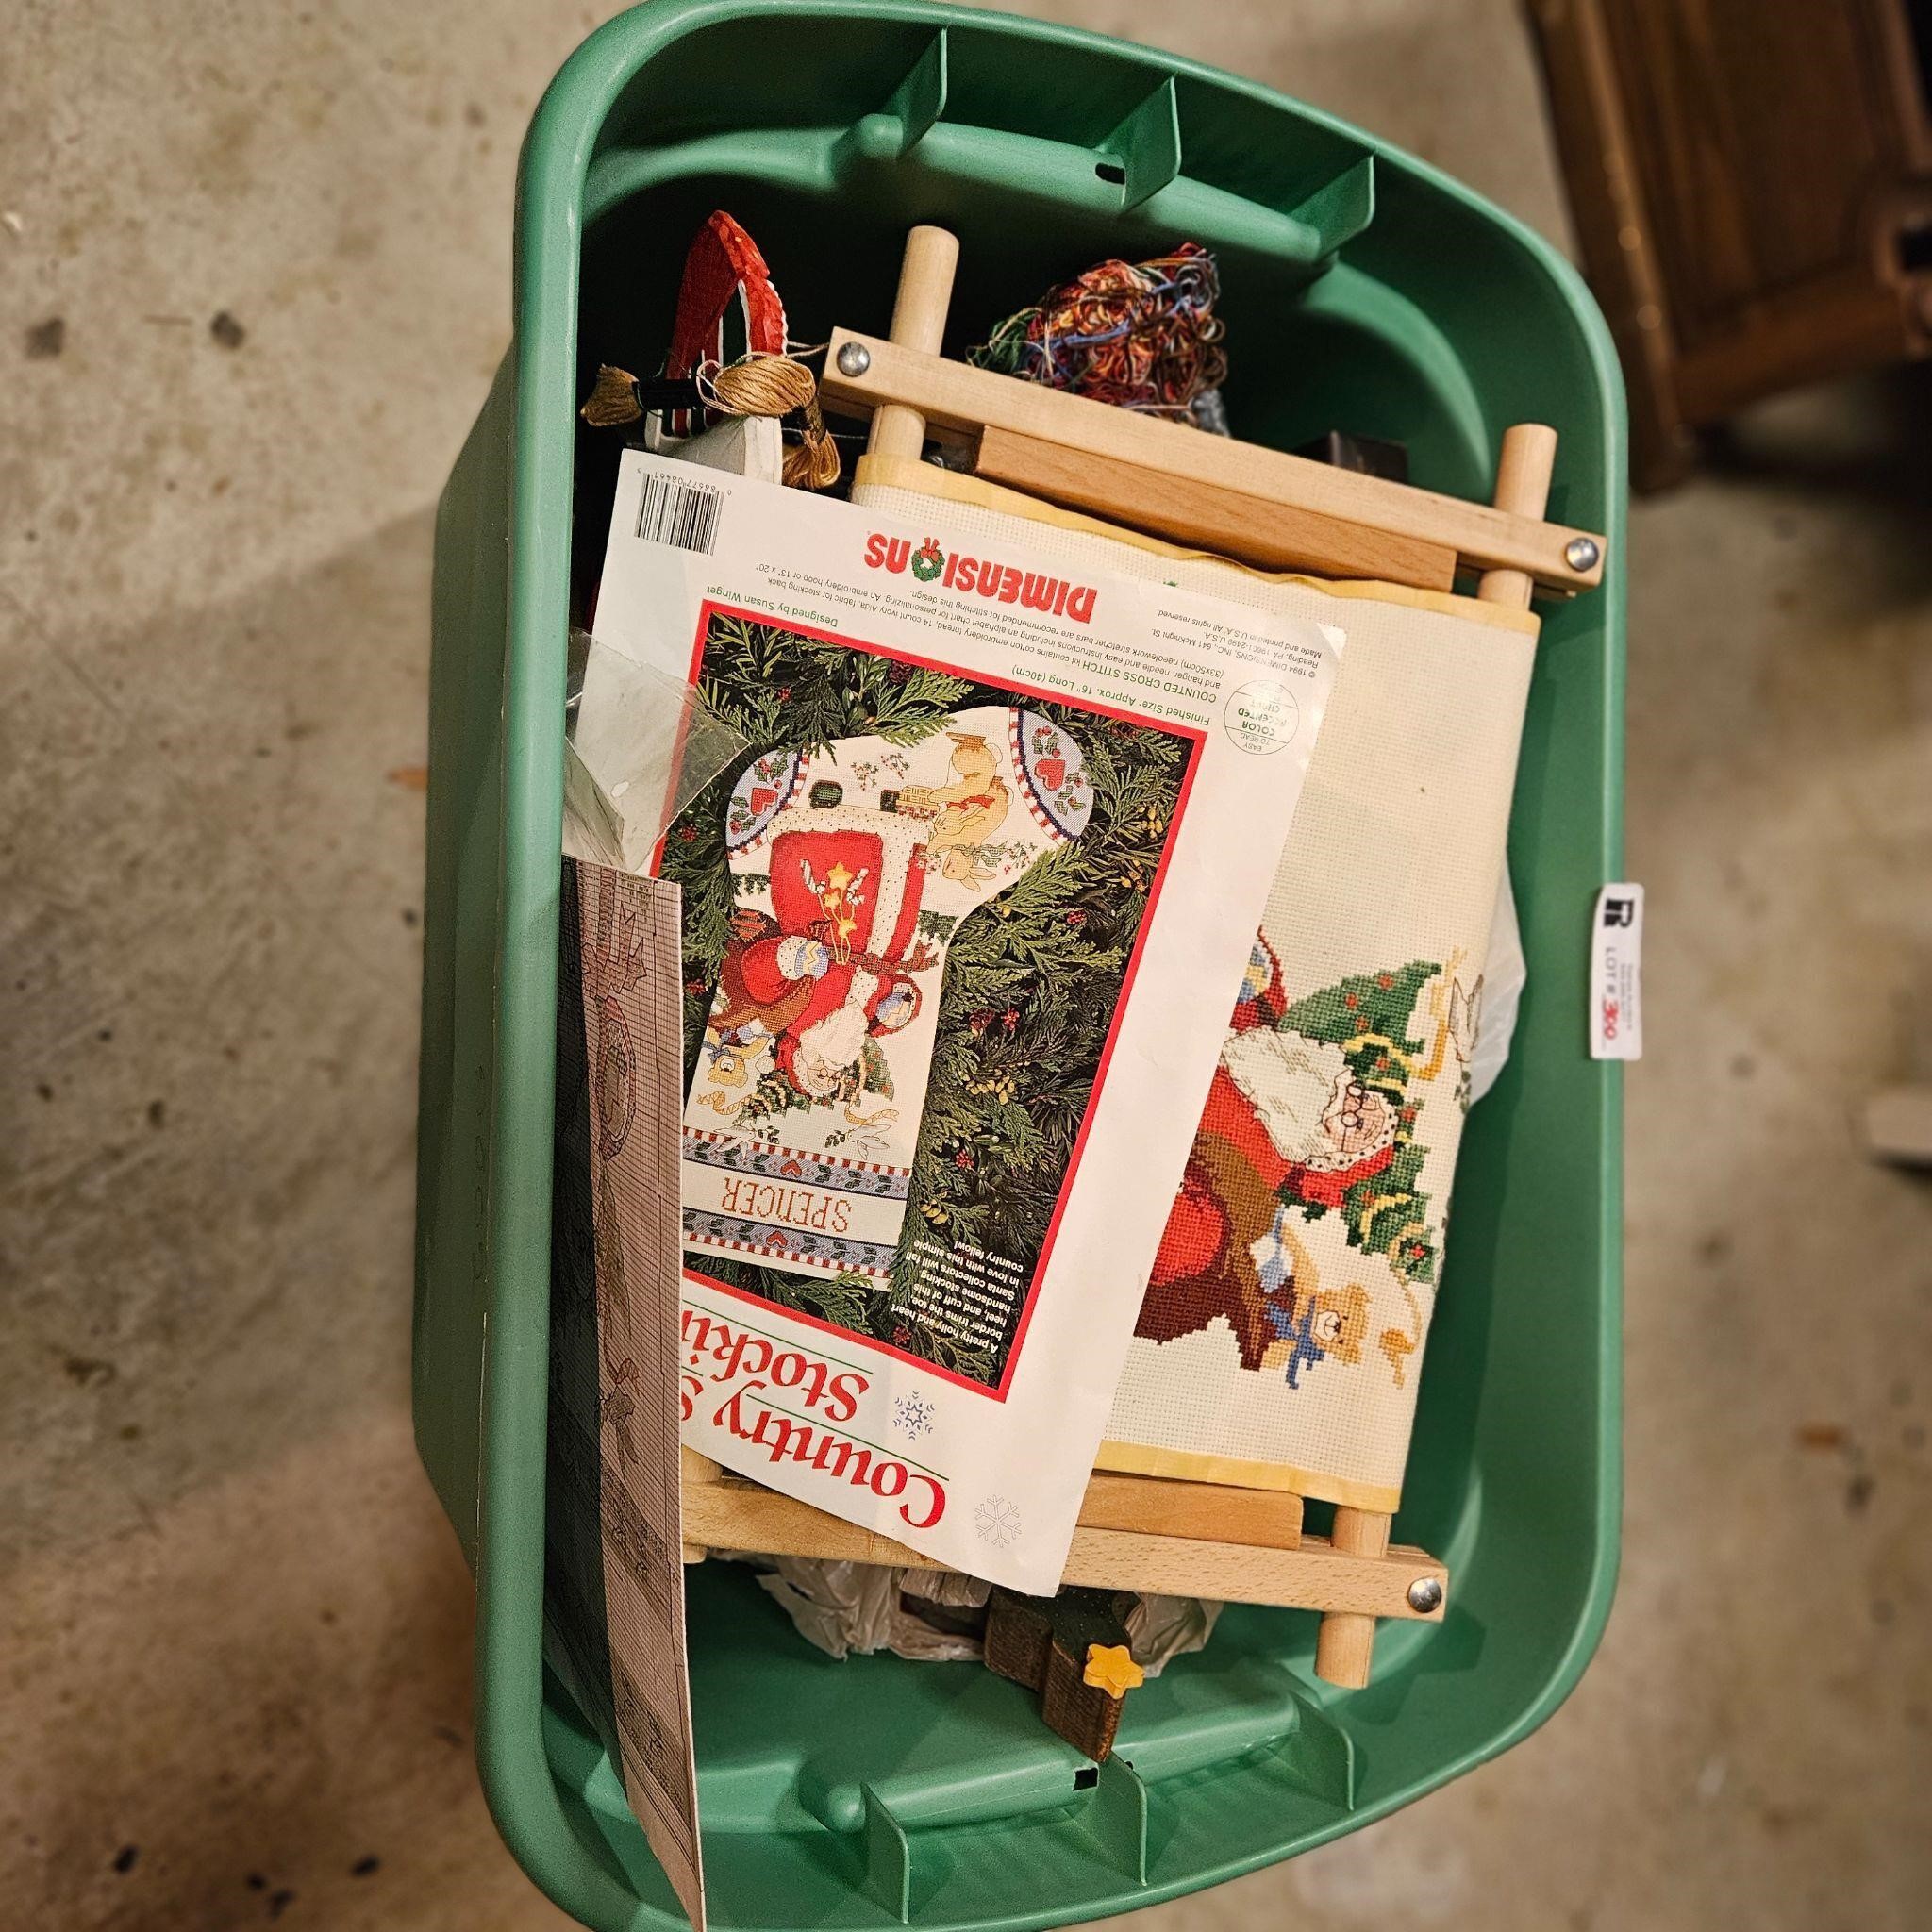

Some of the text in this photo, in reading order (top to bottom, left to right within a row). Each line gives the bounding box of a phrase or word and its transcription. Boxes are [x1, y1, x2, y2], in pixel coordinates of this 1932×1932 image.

[767, 576, 787, 589] back
[791, 571, 802, 579] or
[802, 573, 824, 586] hoop
[787, 580, 821, 596] stocking
[824, 578, 868, 597] embroidery
[821, 591, 833, 600] for
[833, 593, 857, 607] fabric
[869, 591, 881, 602] An
[908, 590, 938, 604] design.
[939, 597, 954, 608] this
[706, 585, 838, 627] Designed by Susan Winget
[878, 605, 898, 617] ivory
[954, 600, 988, 616] stitching
[898, 611, 922, 624] count
[937, 609, 949, 619] for
[949, 612, 971, 625] chart
[988, 610, 1000, 621] for
[923, 618, 932, 626] 14
[935, 619, 962, 635] thread,
[971, 618, 1007, 634] alphabet
[1001, 614, 1059, 635] recommended
[1211, 624, 1224, 632] All
[963, 626, 1008, 646] embroidery
[1007, 627, 1019, 636] an
[1019, 629, 1056, 646] including
[1059, 629, 1074, 639] are
[1074, 633, 1094, 645] bars
[1161, 630, 1197, 646] McKnight
[1009, 641, 1035, 653] cotton
[1057, 641, 1103, 659] instructions
[1093, 639, 1131, 654] stretcher
[1197, 641, 1212, 651] 641
[1283, 642, 1300, 652] and
[1299, 646, 1322, 659] Made
[1036, 647, 1070, 662] contains
[1070, 657, 1081, 667] kit
[1103, 651, 1124, 663] easy
[1131, 648, 1178, 665] needlework
[1272, 650, 1284, 659] PA
[1081, 659, 1121, 678] STITCH
[1124, 658, 1141, 669] and
[1141, 662, 1171, 675] needle
[1288, 665, 1307, 676] 1994
[1010, 663, 1046, 683] (40cm)
[1122, 670, 1161, 689] CROSS
[1172, 669, 1203, 686] hanger,
[1047, 673, 1074, 691] Long
[1204, 678, 1221, 690] and
[1096, 688, 1136, 706] Approx.
[1162, 681, 1216, 703] COUNTED
[1138, 698, 1164, 714] Size:
[1164, 706, 1210, 726] Finished
[1241, 720, 1274, 736] COLOR
[1242, 741, 1262, 752] EASY
[1605, 946, 1616, 981] LOT
[721, 1175, 853, 1233] SPENCER
[912, 1239, 1020, 1288] in love with this simple
[953, 1240, 1024, 1273] country fellow!
[905, 1250, 1015, 1301] Santa collectors will fall
[912, 1282, 1007, 1327] heel, and cuff of this
[961, 1287, 1011, 1314] handsome
[927, 1303, 943, 1317] the
[944, 1309, 969, 1327] trims
[891, 1302, 999, 1354] A pretty holly and heart
[968, 1321, 1003, 1341] border
[712, 1370, 947, 1528] Country
